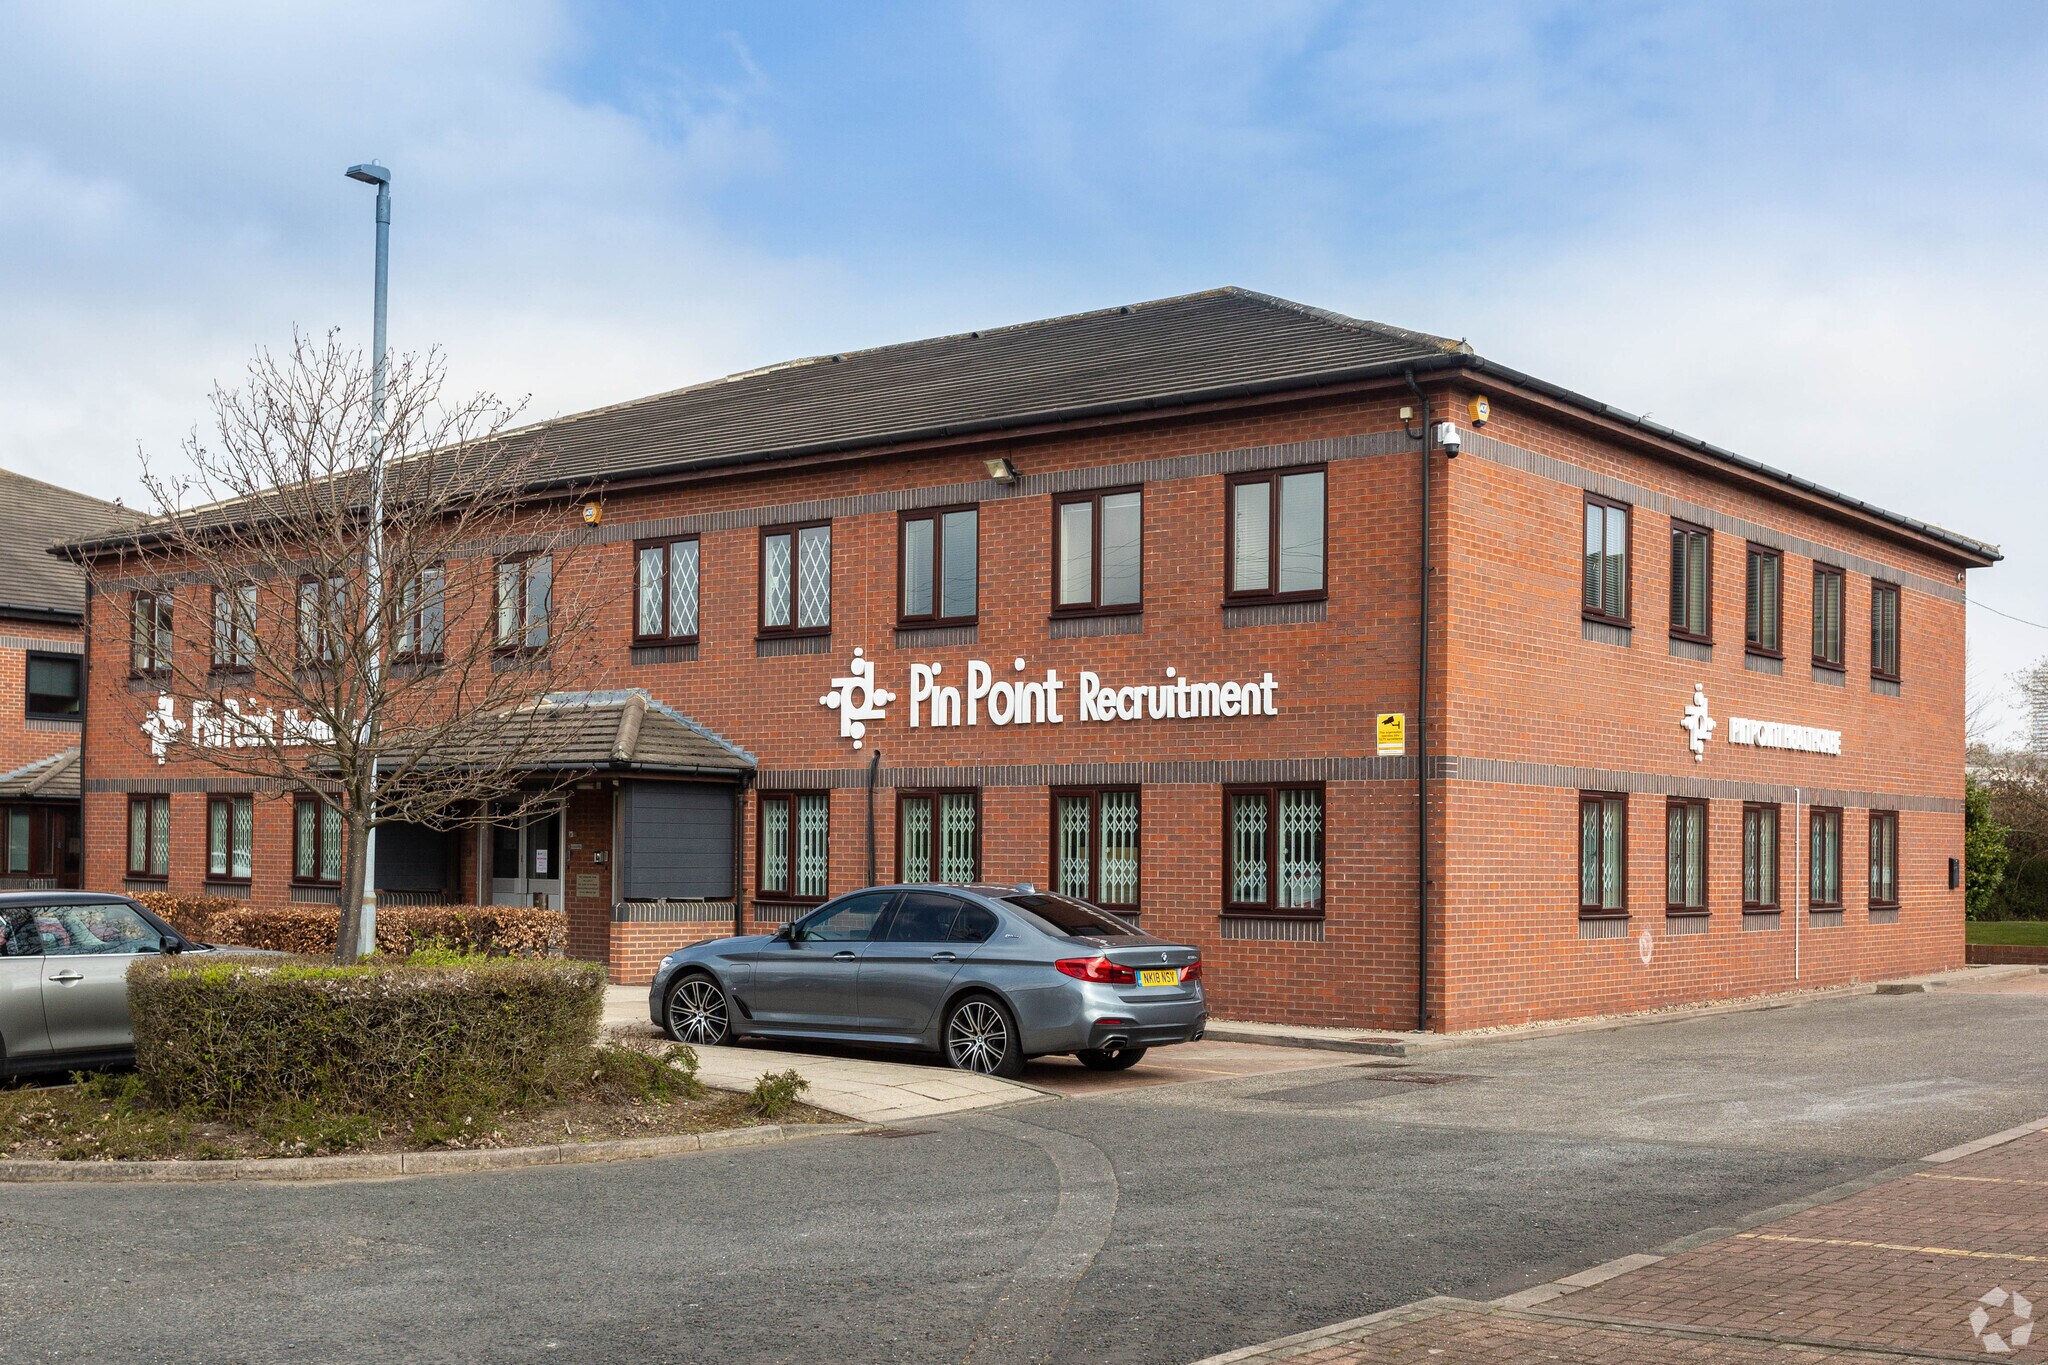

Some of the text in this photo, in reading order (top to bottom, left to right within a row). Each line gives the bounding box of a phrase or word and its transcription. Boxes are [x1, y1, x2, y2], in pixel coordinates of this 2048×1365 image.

[910, 657, 1279, 727] Pin Point Recruitment
[1143, 971, 1161, 984] NK18
